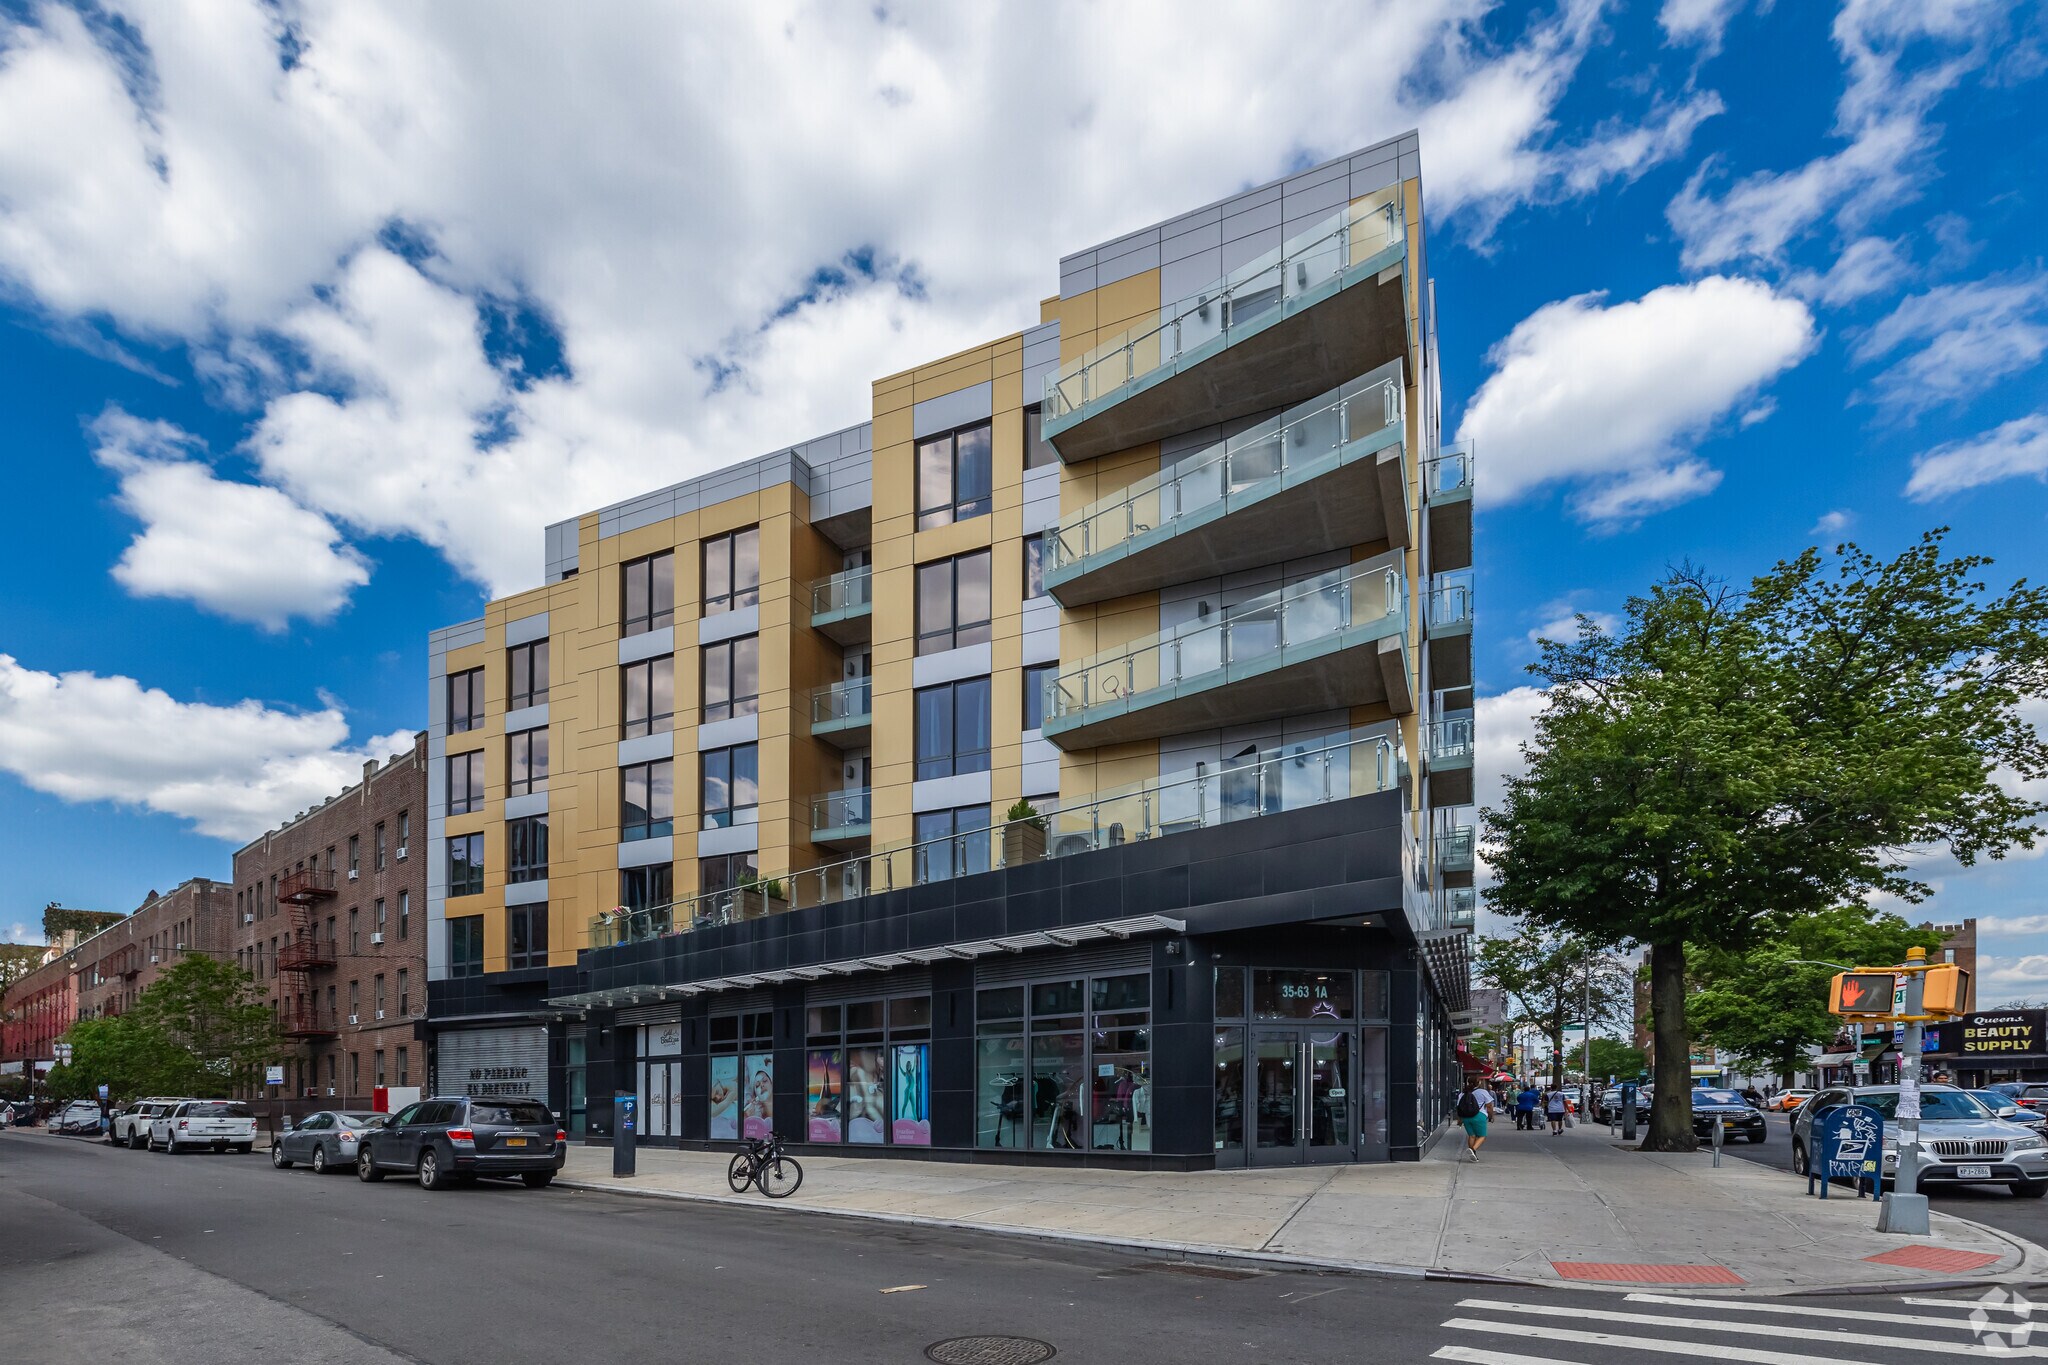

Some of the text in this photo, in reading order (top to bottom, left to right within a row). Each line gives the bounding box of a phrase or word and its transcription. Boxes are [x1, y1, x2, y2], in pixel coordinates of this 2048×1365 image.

[1282, 985, 1328, 998] 35-63 1A
[1964, 1026, 2033, 1038] BEAUTY
[1964, 1039, 2033, 1052] SUPPLY
[469, 1067, 528, 1080] NO PARKING
[627, 1101, 633, 1110] P
